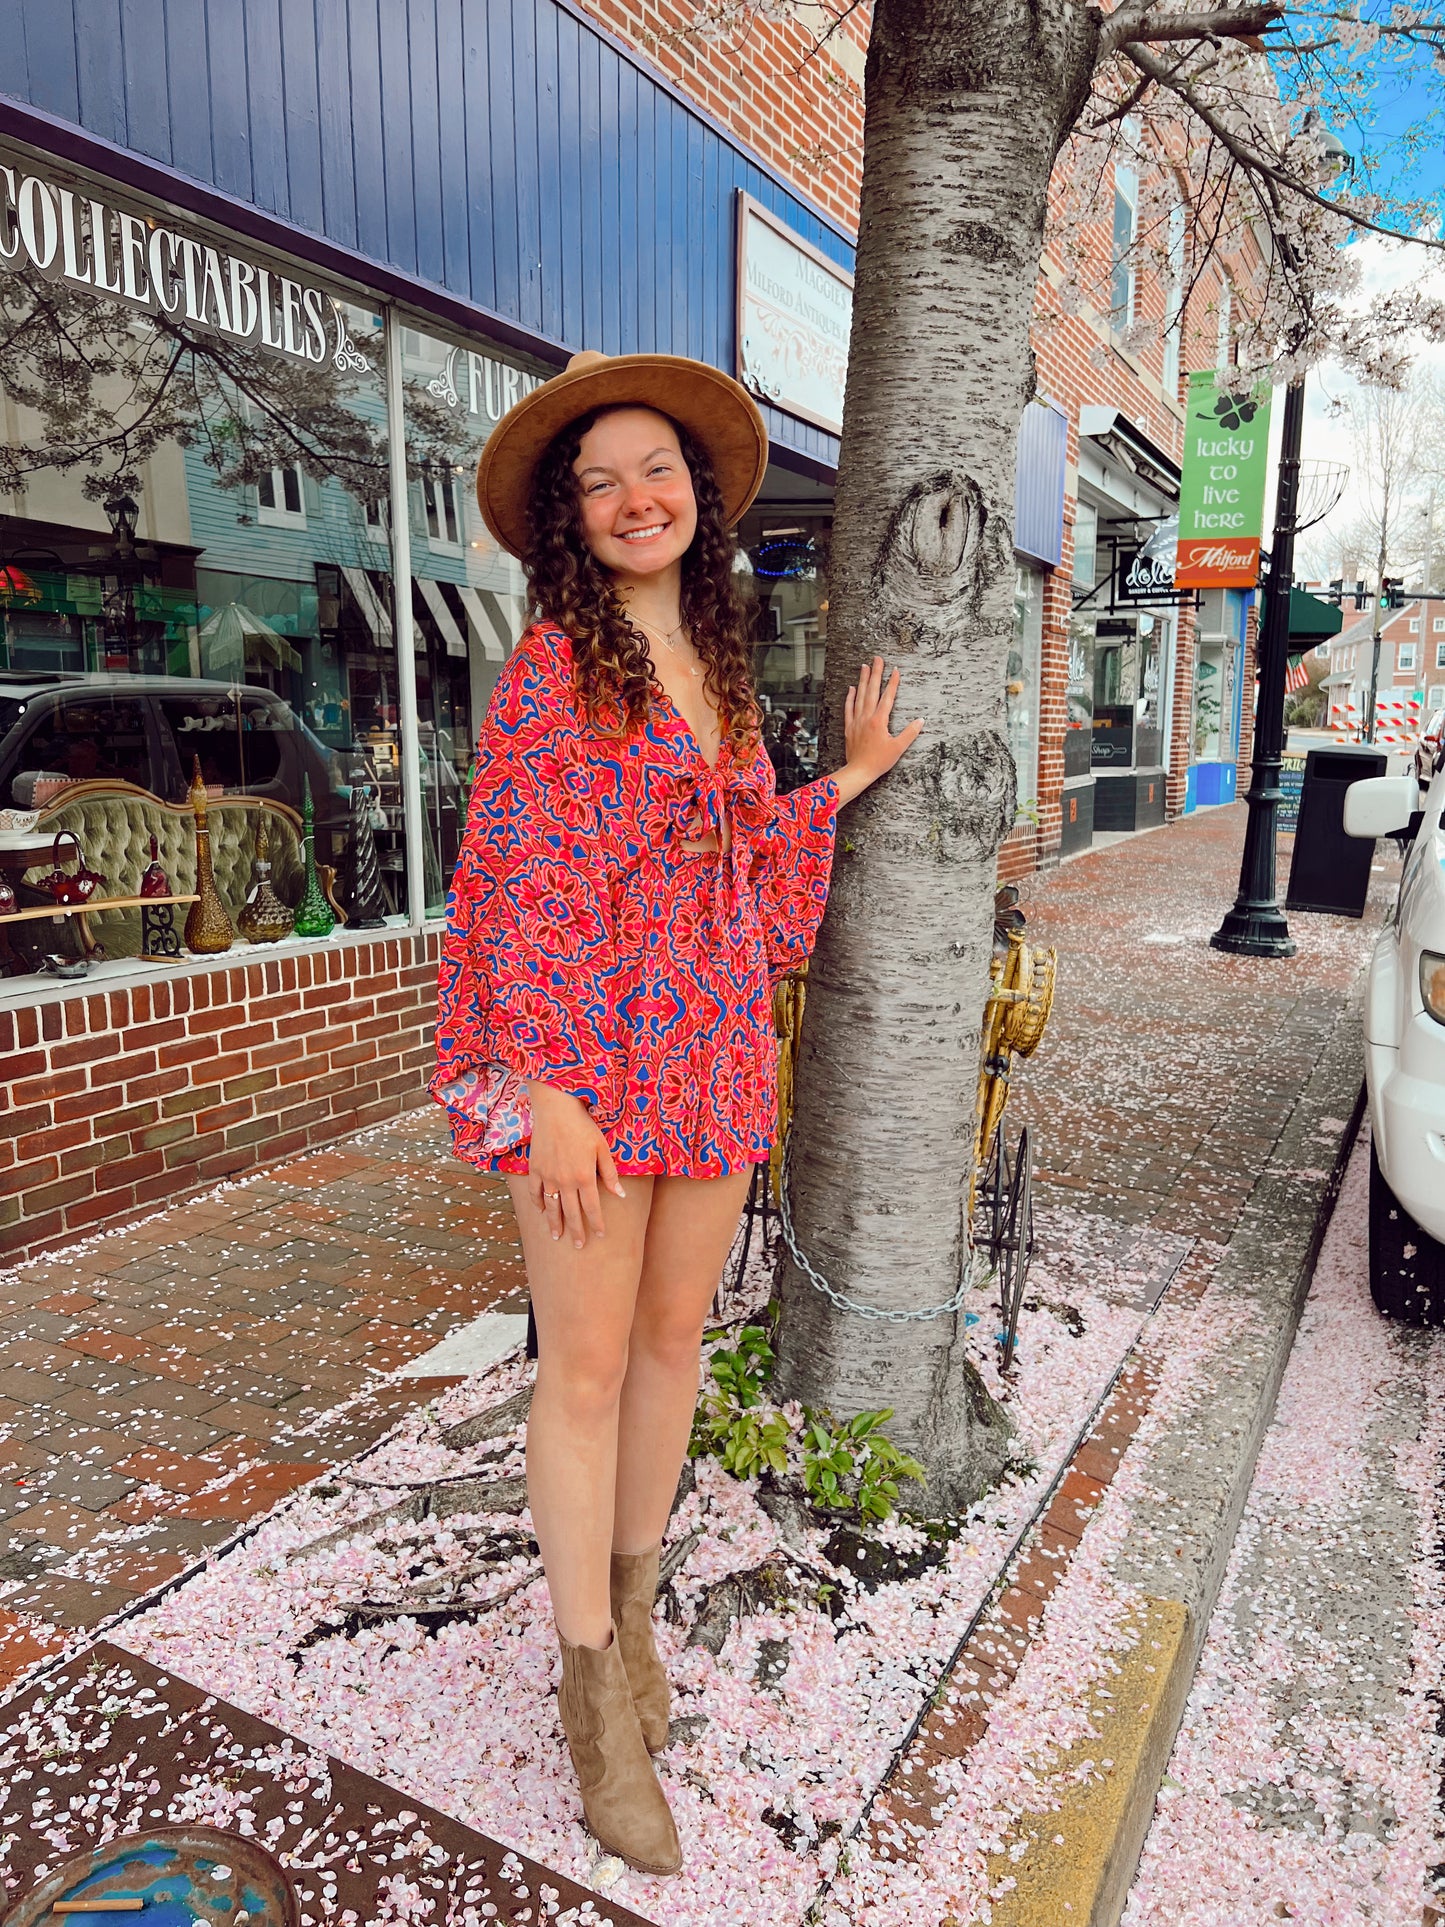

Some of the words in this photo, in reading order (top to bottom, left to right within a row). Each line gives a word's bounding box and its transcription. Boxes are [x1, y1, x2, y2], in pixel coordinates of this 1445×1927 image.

[0, 165, 326, 363] COLLECTABLES
[468, 350, 546, 421] FURN
[1197, 437, 1254, 460] lucky
[1210, 465, 1237, 480] to
[1203, 485, 1240, 505] live
[1194, 510, 1245, 529] here
[1177, 545, 1255, 572] Milford
